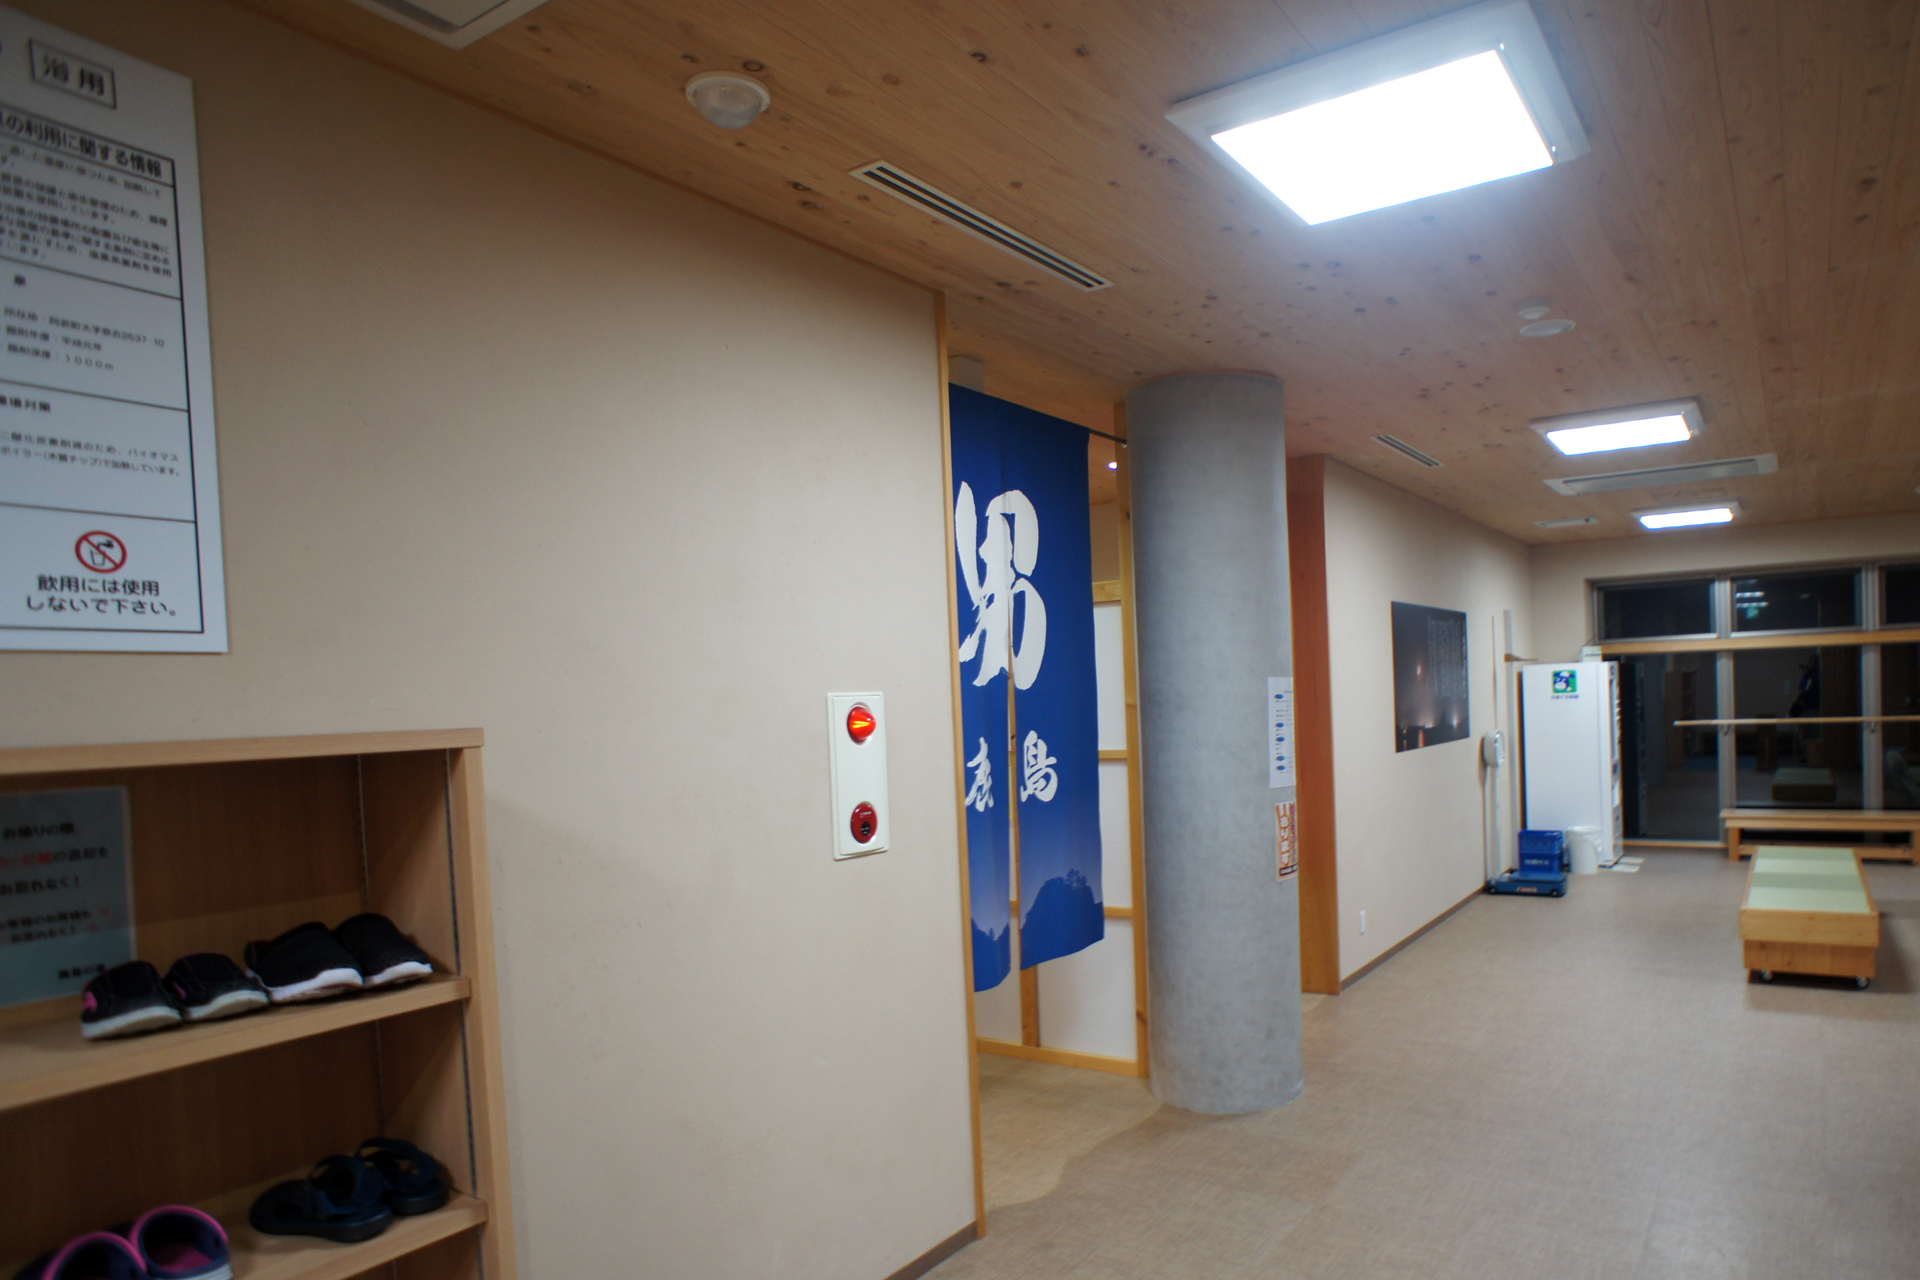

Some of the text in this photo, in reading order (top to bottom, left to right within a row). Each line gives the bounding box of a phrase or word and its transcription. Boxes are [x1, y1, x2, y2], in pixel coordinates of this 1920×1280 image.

[0, 111, 162, 178] の利用に関する情報
[37, 573, 160, 597] 飲用には使用
[27, 594, 176, 616] しないで下さい。
